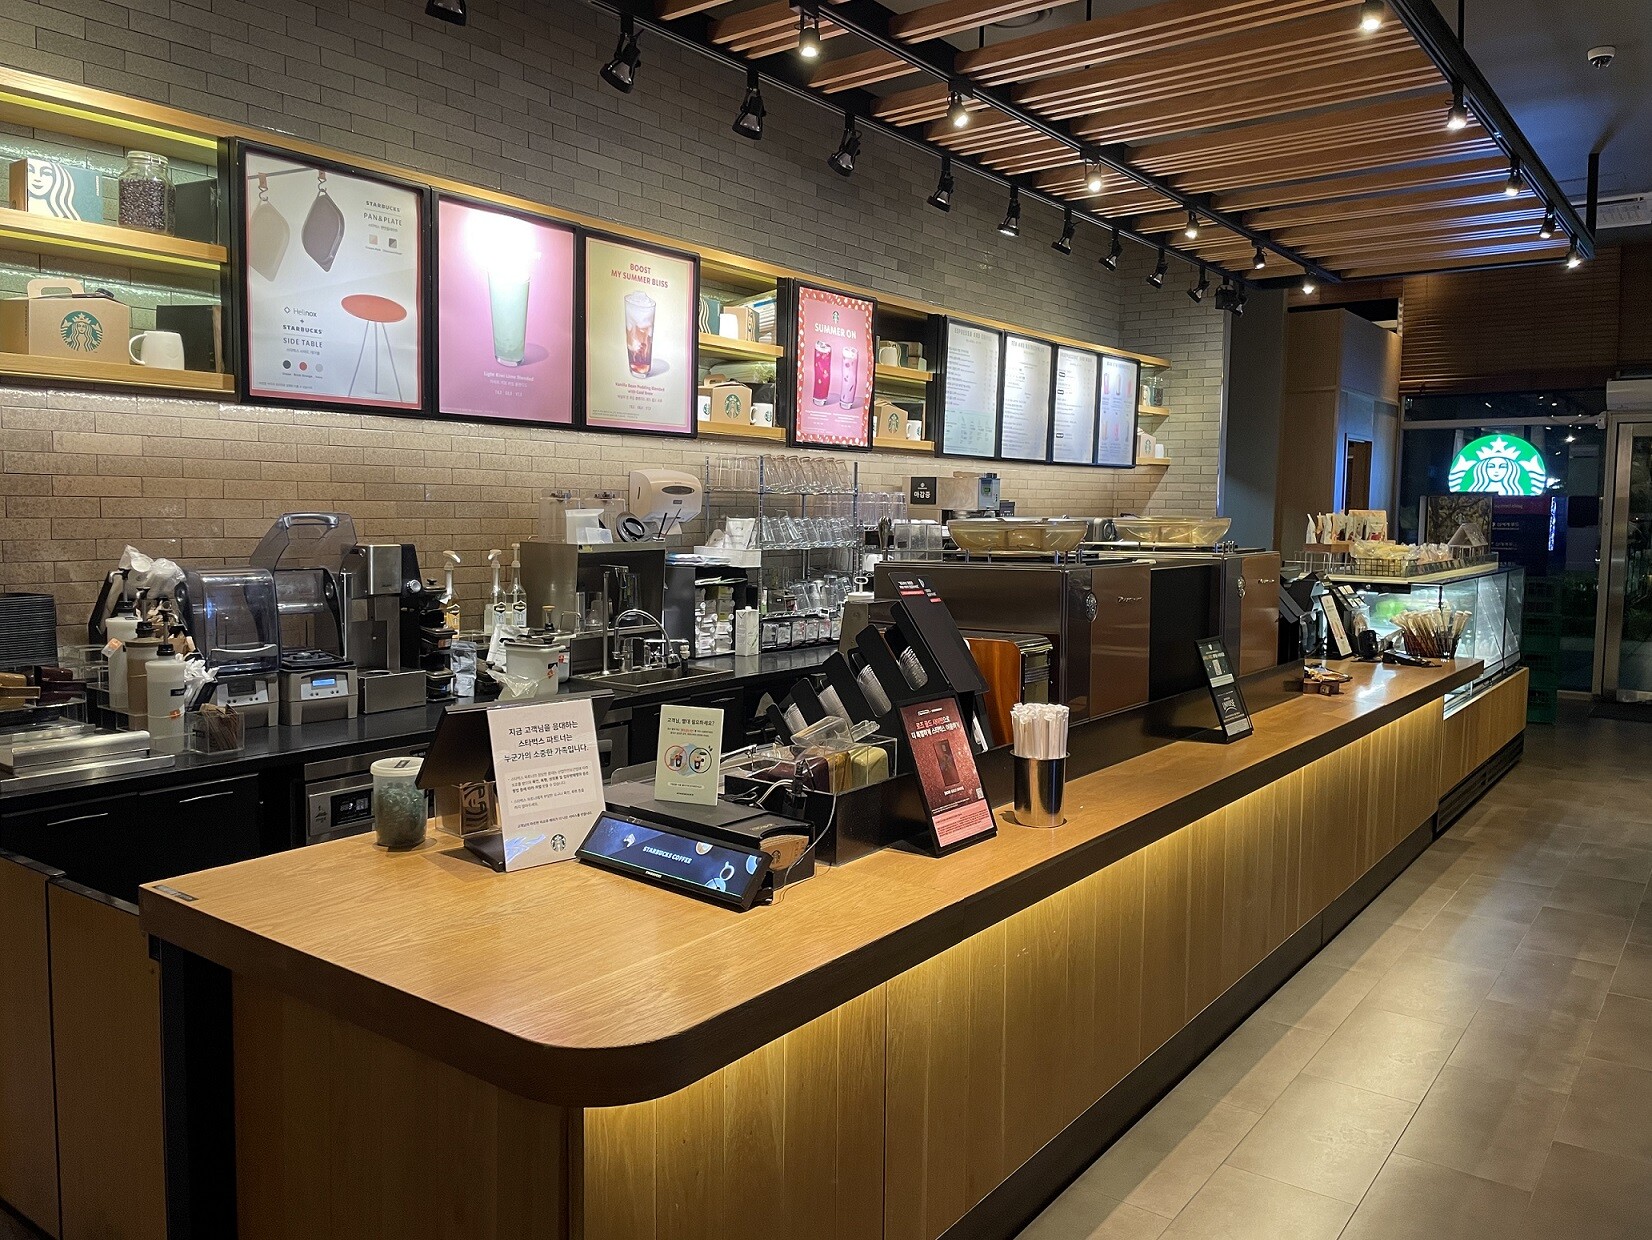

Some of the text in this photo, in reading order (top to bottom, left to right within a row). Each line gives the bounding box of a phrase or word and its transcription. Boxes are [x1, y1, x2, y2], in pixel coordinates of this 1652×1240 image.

[366, 200, 400, 212] STARBUCKS
[363, 212, 402, 227] PAN&PLATE
[630, 263, 651, 274] BOOST
[611, 269, 669, 289] MY SUMMER BLISS
[293, 308, 318, 318] Helinox
[282, 324, 322, 335] STARBUCKS
[814, 322, 857, 340] SUMMER ON
[283, 337, 323, 349] SIDE TABLE
[913, 490, 931, 499] 마감중
[508, 720, 579, 736] 지금 고객님을 응대하는
[518, 733, 573, 748] 스타벅스 파트너는
[504, 743, 589, 763] 누군가의 소중한 가족입니다.
[642, 846, 693, 864] STARBUCKS COFFEE
